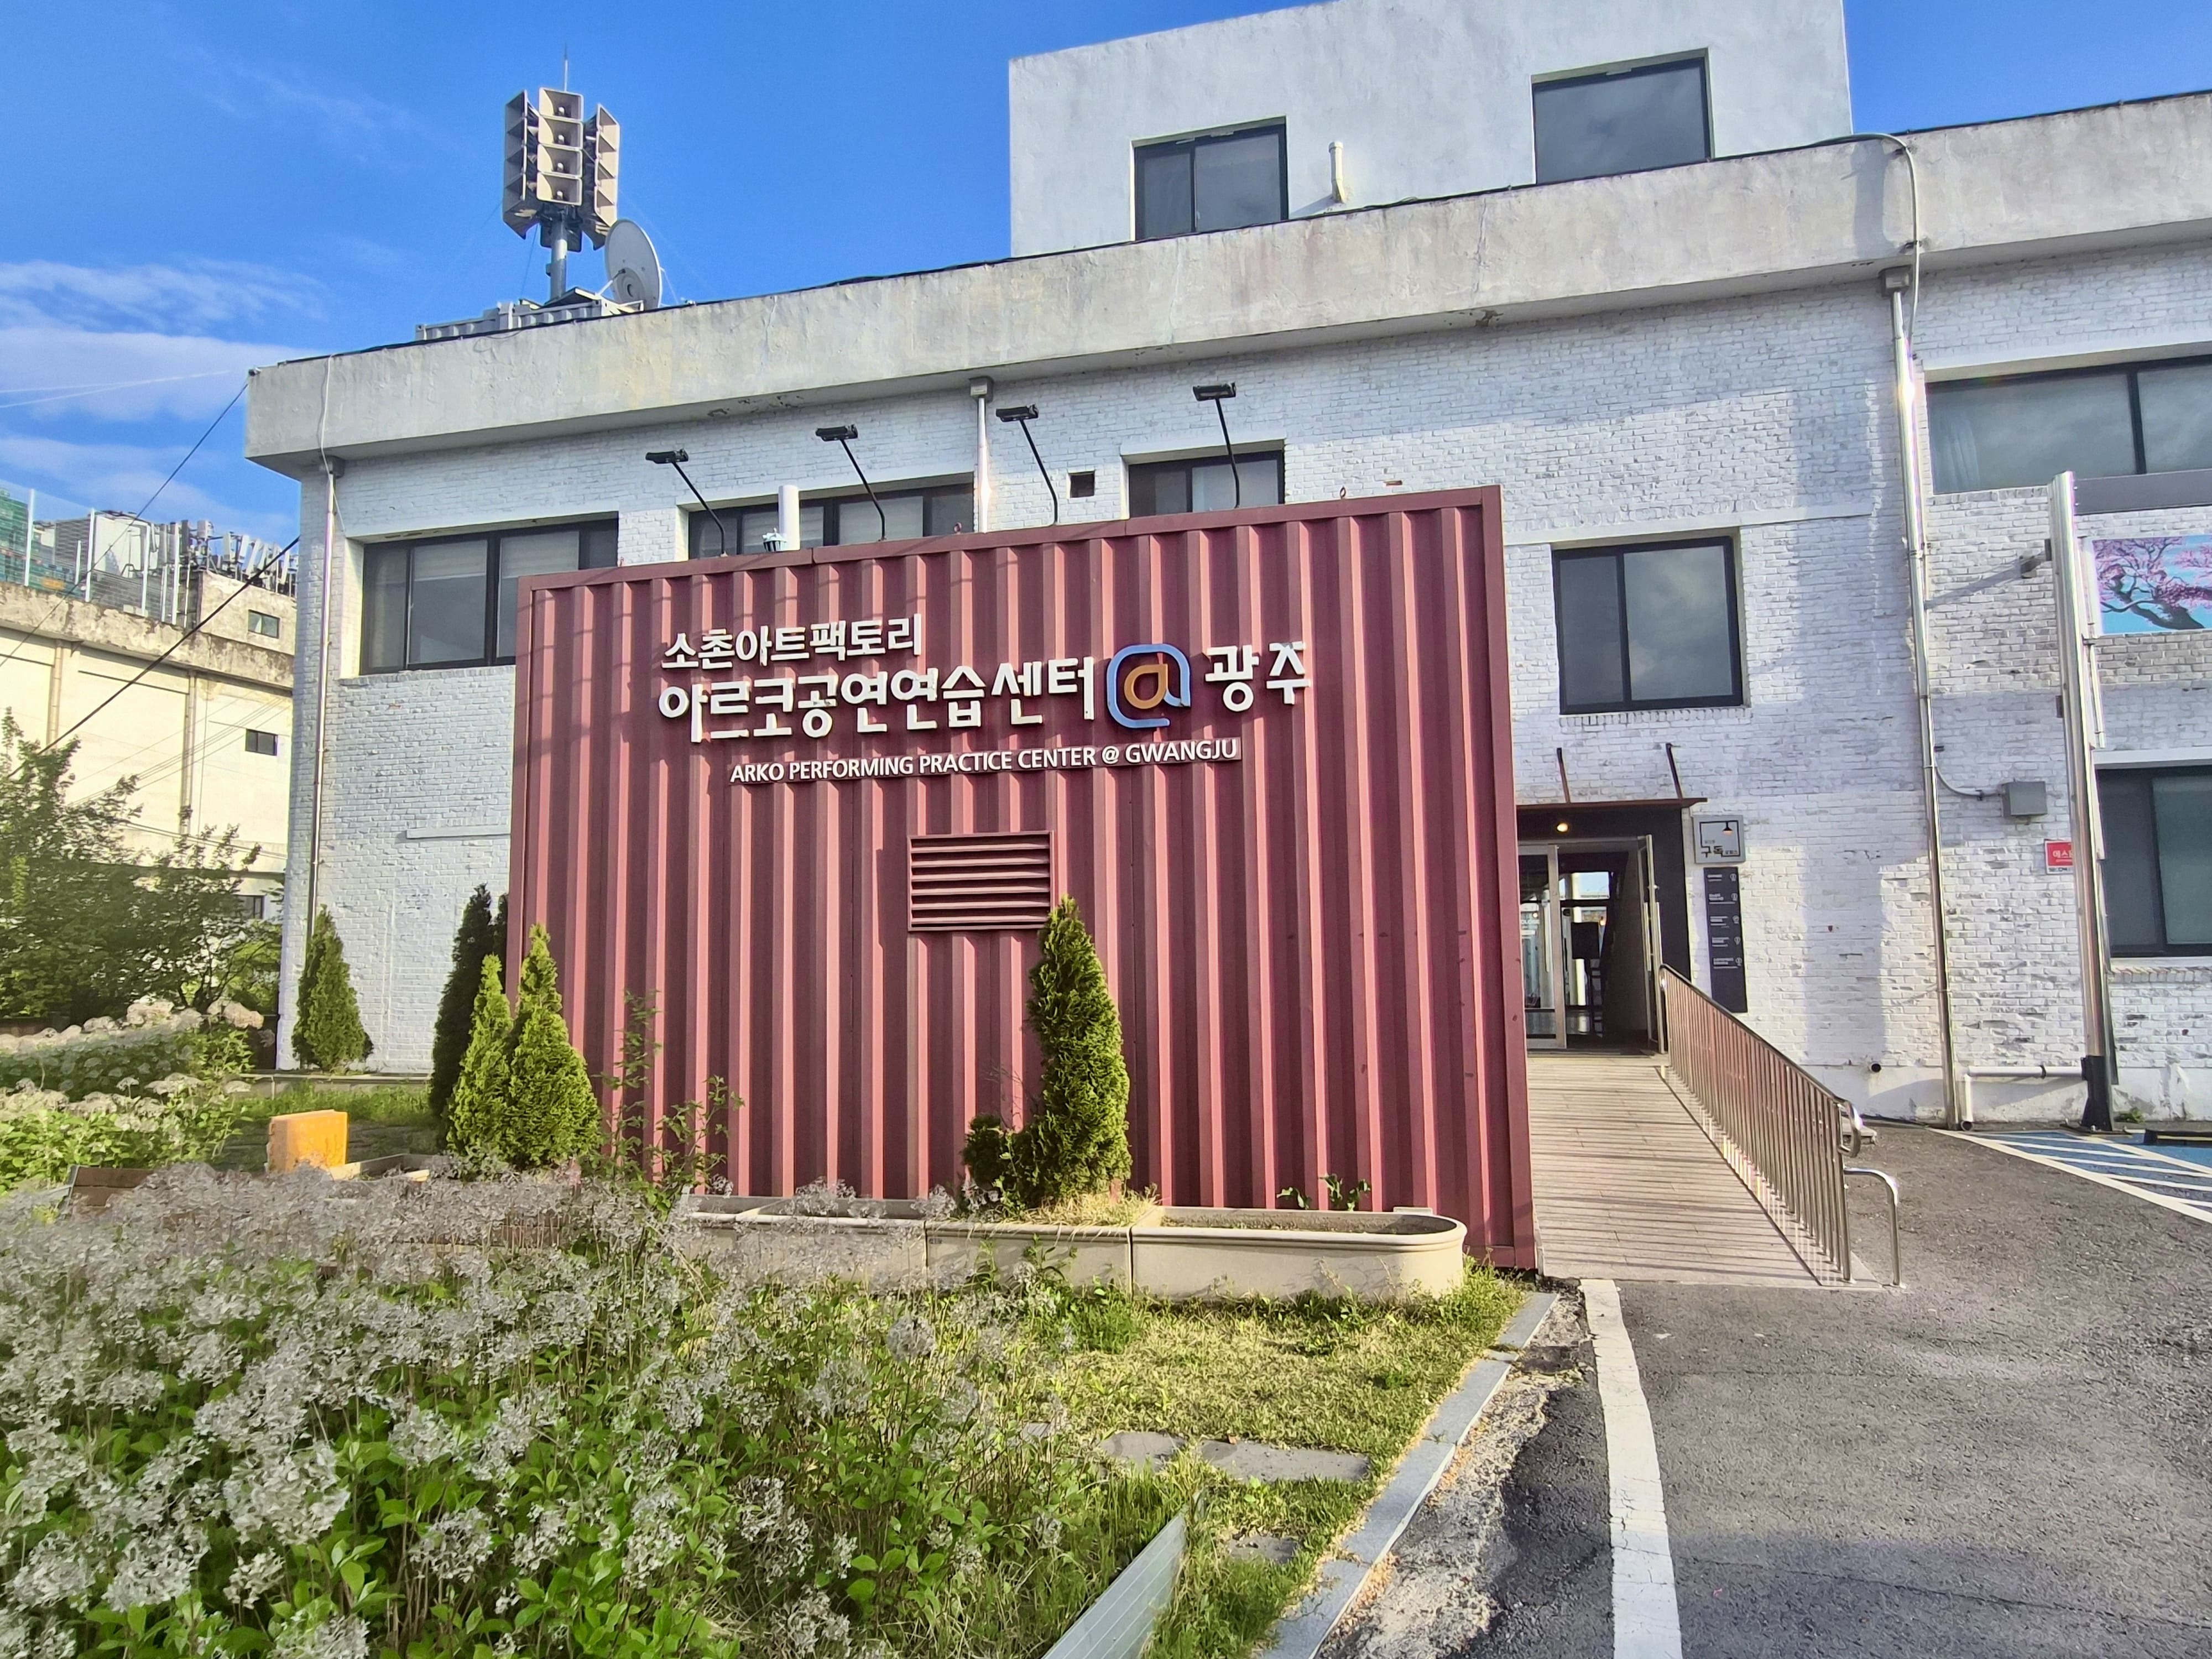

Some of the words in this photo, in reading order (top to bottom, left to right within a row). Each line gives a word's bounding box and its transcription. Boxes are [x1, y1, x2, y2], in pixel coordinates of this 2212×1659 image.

[661, 613, 922, 670] 소촌아트팩토리
[730, 763, 785, 783] ARKO
[789, 756, 915, 780] PERFORMING
[919, 750, 1013, 775] PRACTICE
[1018, 747, 1096, 769] CENTER
[1101, 746, 1120, 765] @
[1125, 738, 1238, 764] GWANGJU
